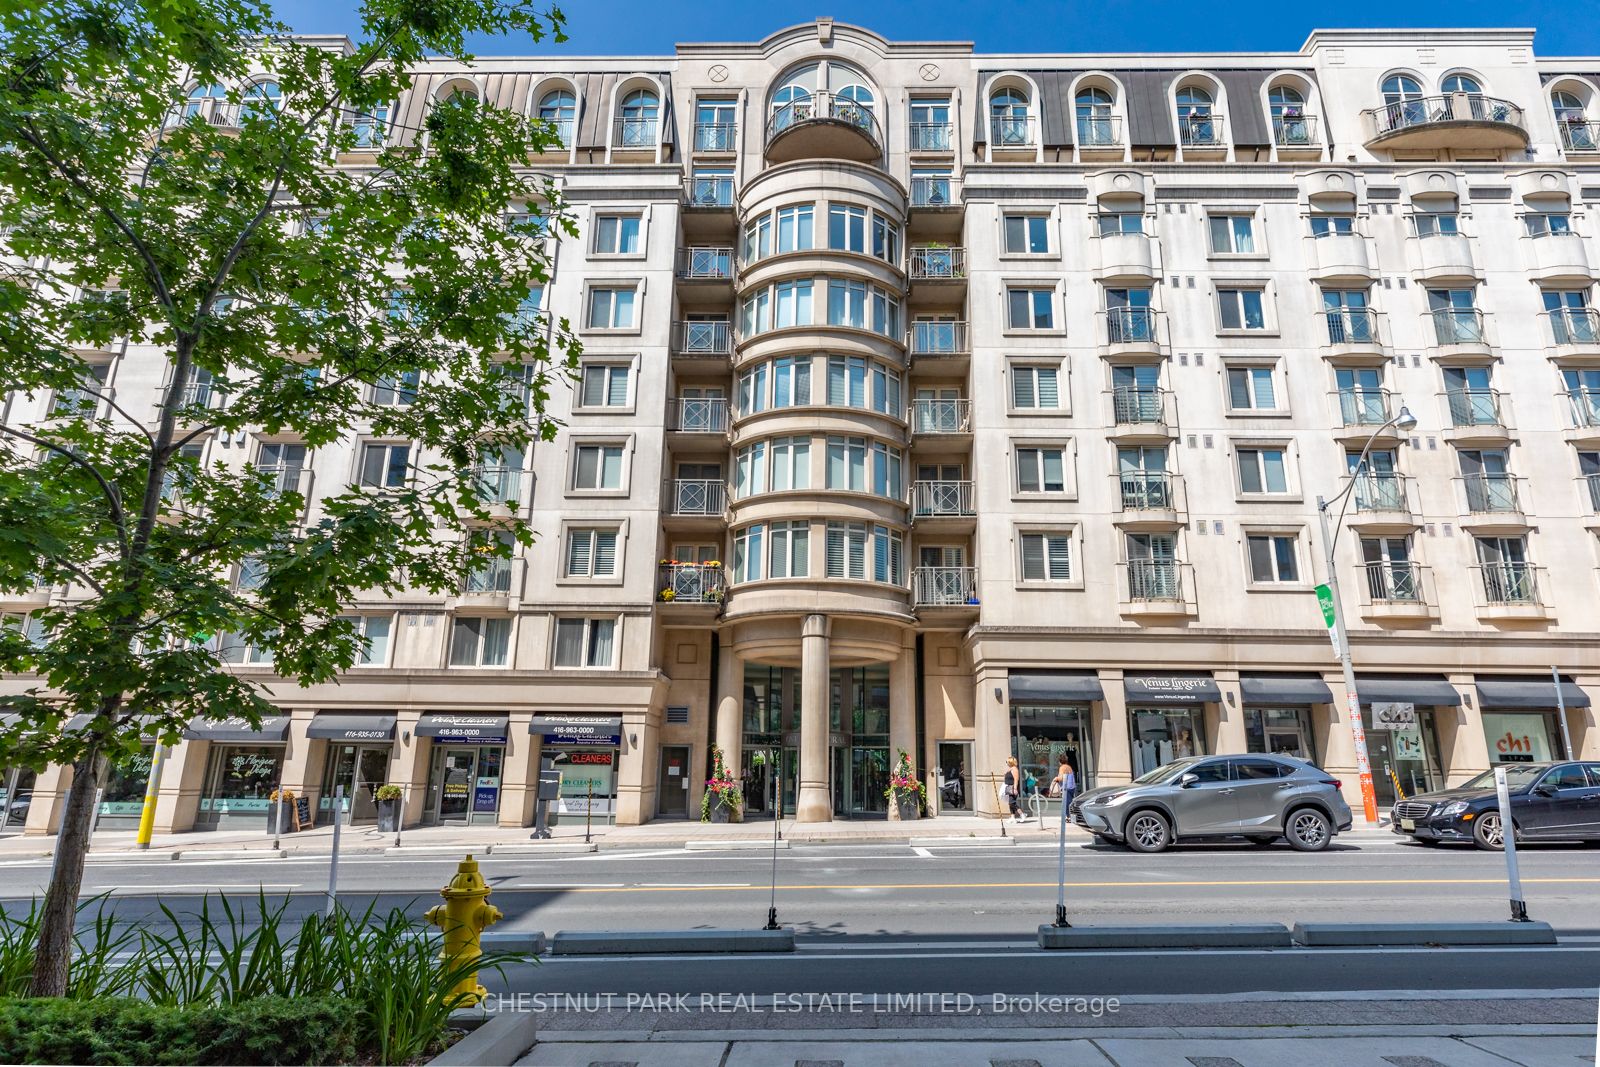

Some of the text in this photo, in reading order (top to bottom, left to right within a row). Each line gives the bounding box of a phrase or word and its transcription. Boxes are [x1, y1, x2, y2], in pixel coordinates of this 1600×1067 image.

[1134, 677, 1207, 690] Venus Lingerie
[1025, 741, 1050, 751] Venus
[1496, 731, 1531, 752] chi
[571, 754, 611, 763] CLEANERS
